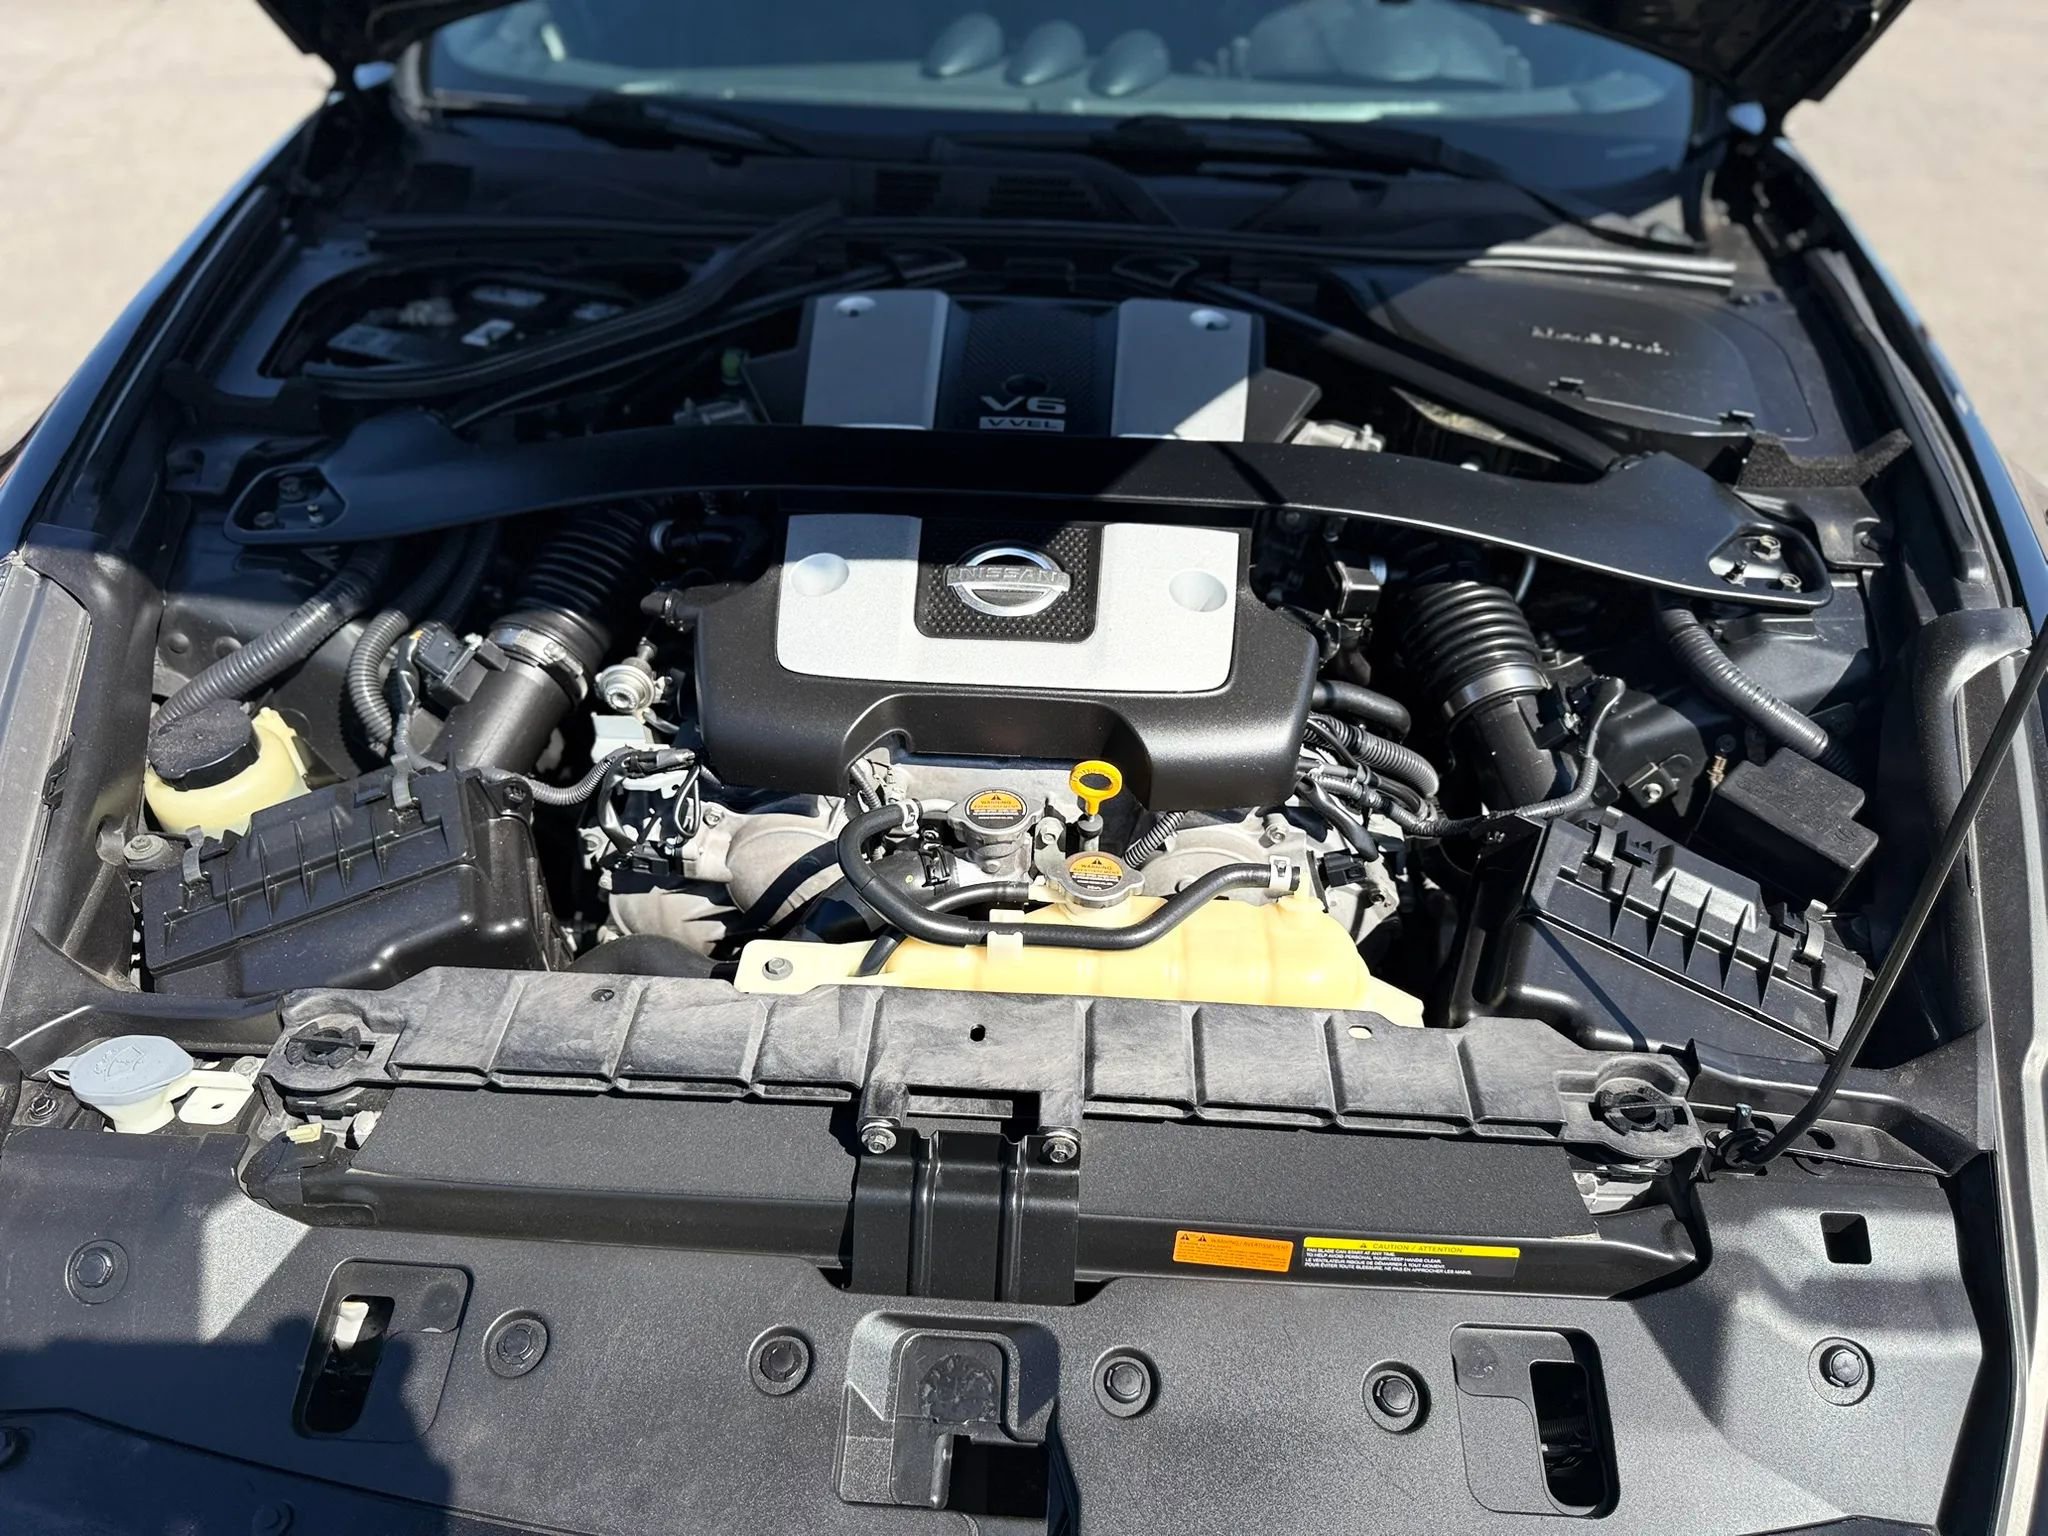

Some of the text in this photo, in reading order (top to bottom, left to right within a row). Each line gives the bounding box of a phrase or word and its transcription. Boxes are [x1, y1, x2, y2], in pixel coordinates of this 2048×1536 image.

[980, 396, 1066, 414] V6
[987, 418, 1056, 428] VVEL
[960, 567, 1058, 582] NISSAN
